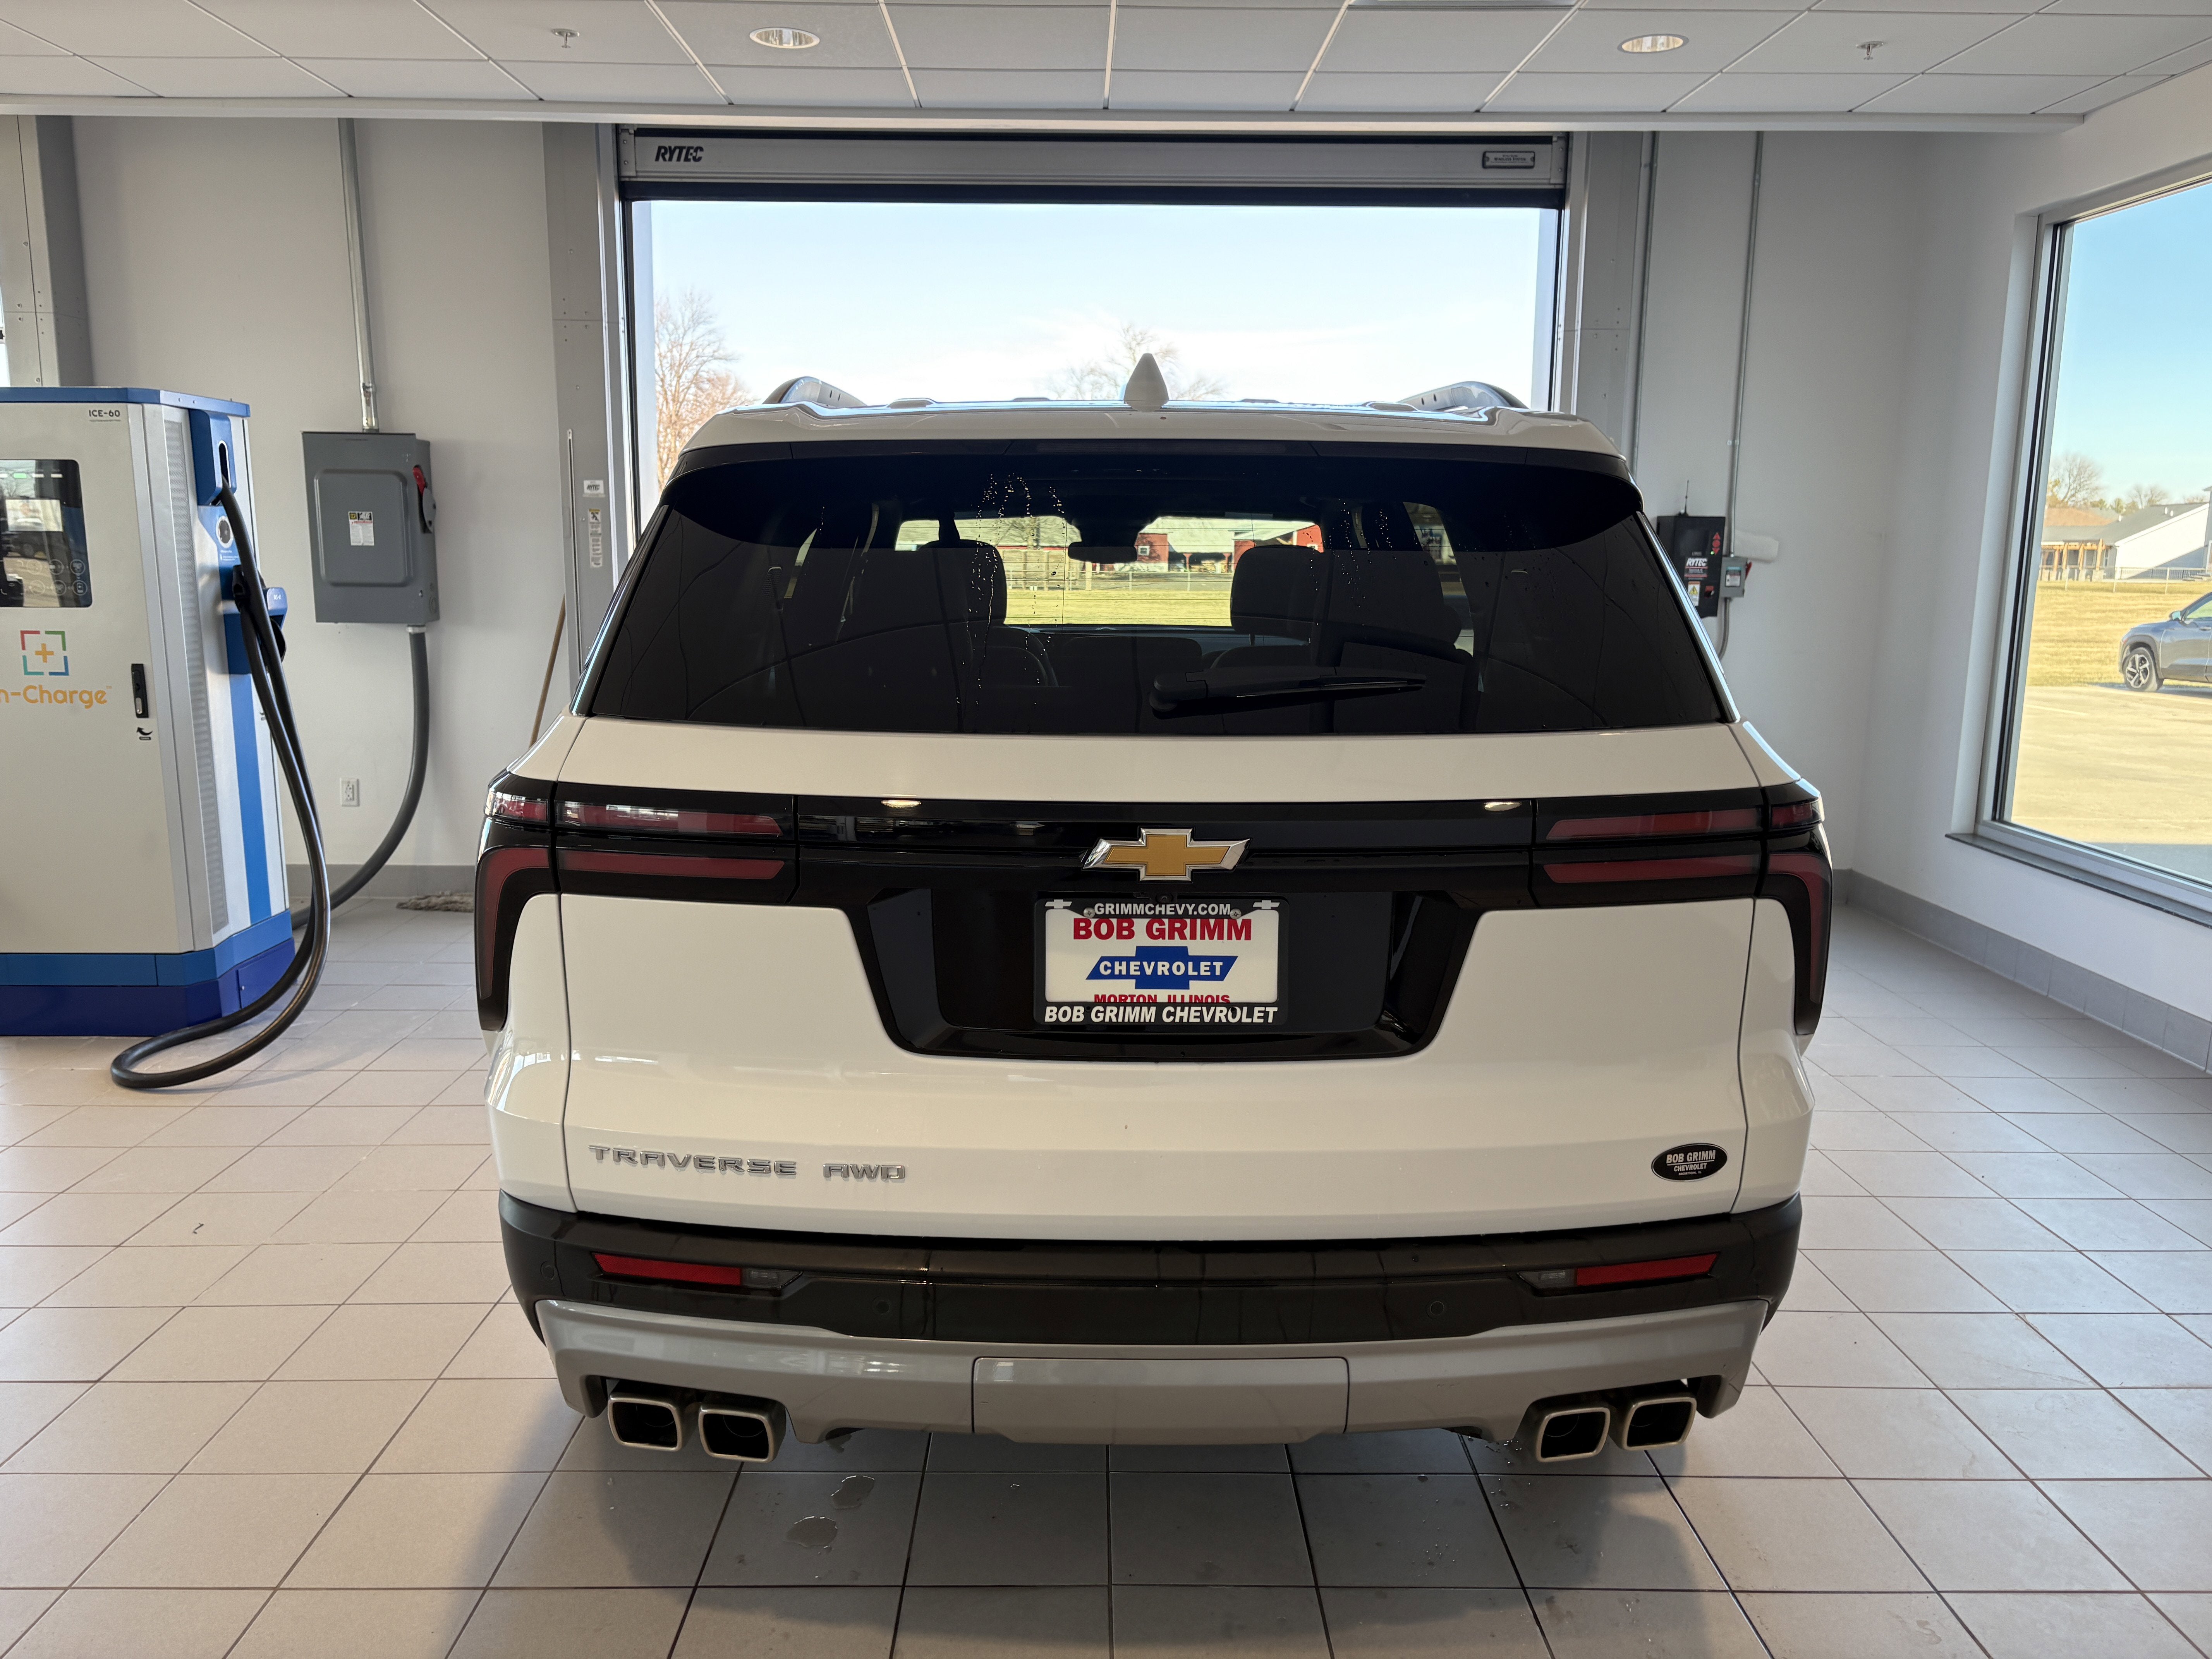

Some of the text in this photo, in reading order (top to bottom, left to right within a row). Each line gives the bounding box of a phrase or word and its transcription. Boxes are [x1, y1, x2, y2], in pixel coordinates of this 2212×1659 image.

[655, 146, 704, 162] RYTEC
[1686, 558, 1707, 567] RYTEC
[1094, 903, 1231, 915] GRIMMCHEVY.COM
[1073, 918, 1252, 940] BOB GRIMM
[1099, 961, 1223, 975] CHEVROLET
[1094, 994, 1157, 1003] MORTON
[1045, 1006, 1278, 1023] BOB GRIMM CHEVROLET
[588, 1145, 906, 1180] TRAVERSE AWD
[1666, 1150, 1716, 1164] BOB GRIMM
[1674, 1163, 1707, 1171] CHEVROLET
